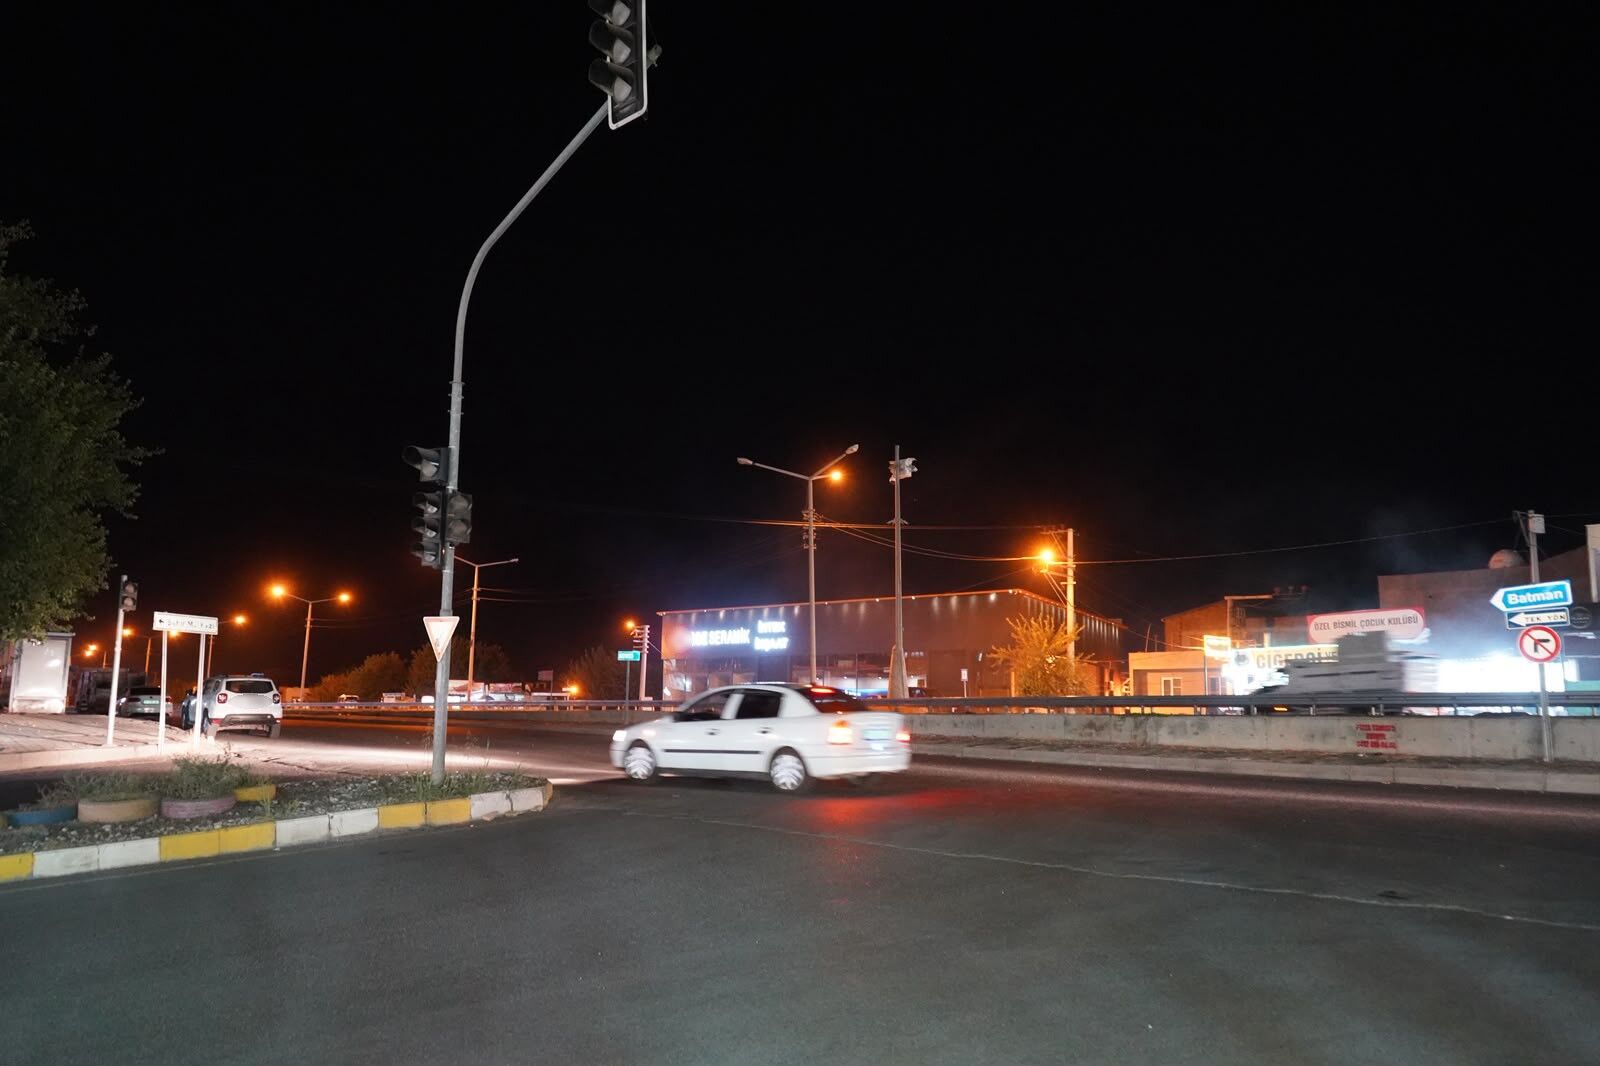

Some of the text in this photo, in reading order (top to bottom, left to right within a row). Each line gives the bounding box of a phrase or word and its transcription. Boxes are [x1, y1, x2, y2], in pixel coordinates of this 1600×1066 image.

[1507, 590, 1564, 605] Batman
[1314, 620, 1331, 631] ÖZEL
[1333, 618, 1358, 630] BİSMİL
[1360, 616, 1386, 629] ÇOCUK
[1525, 615, 1541, 623] TEK
